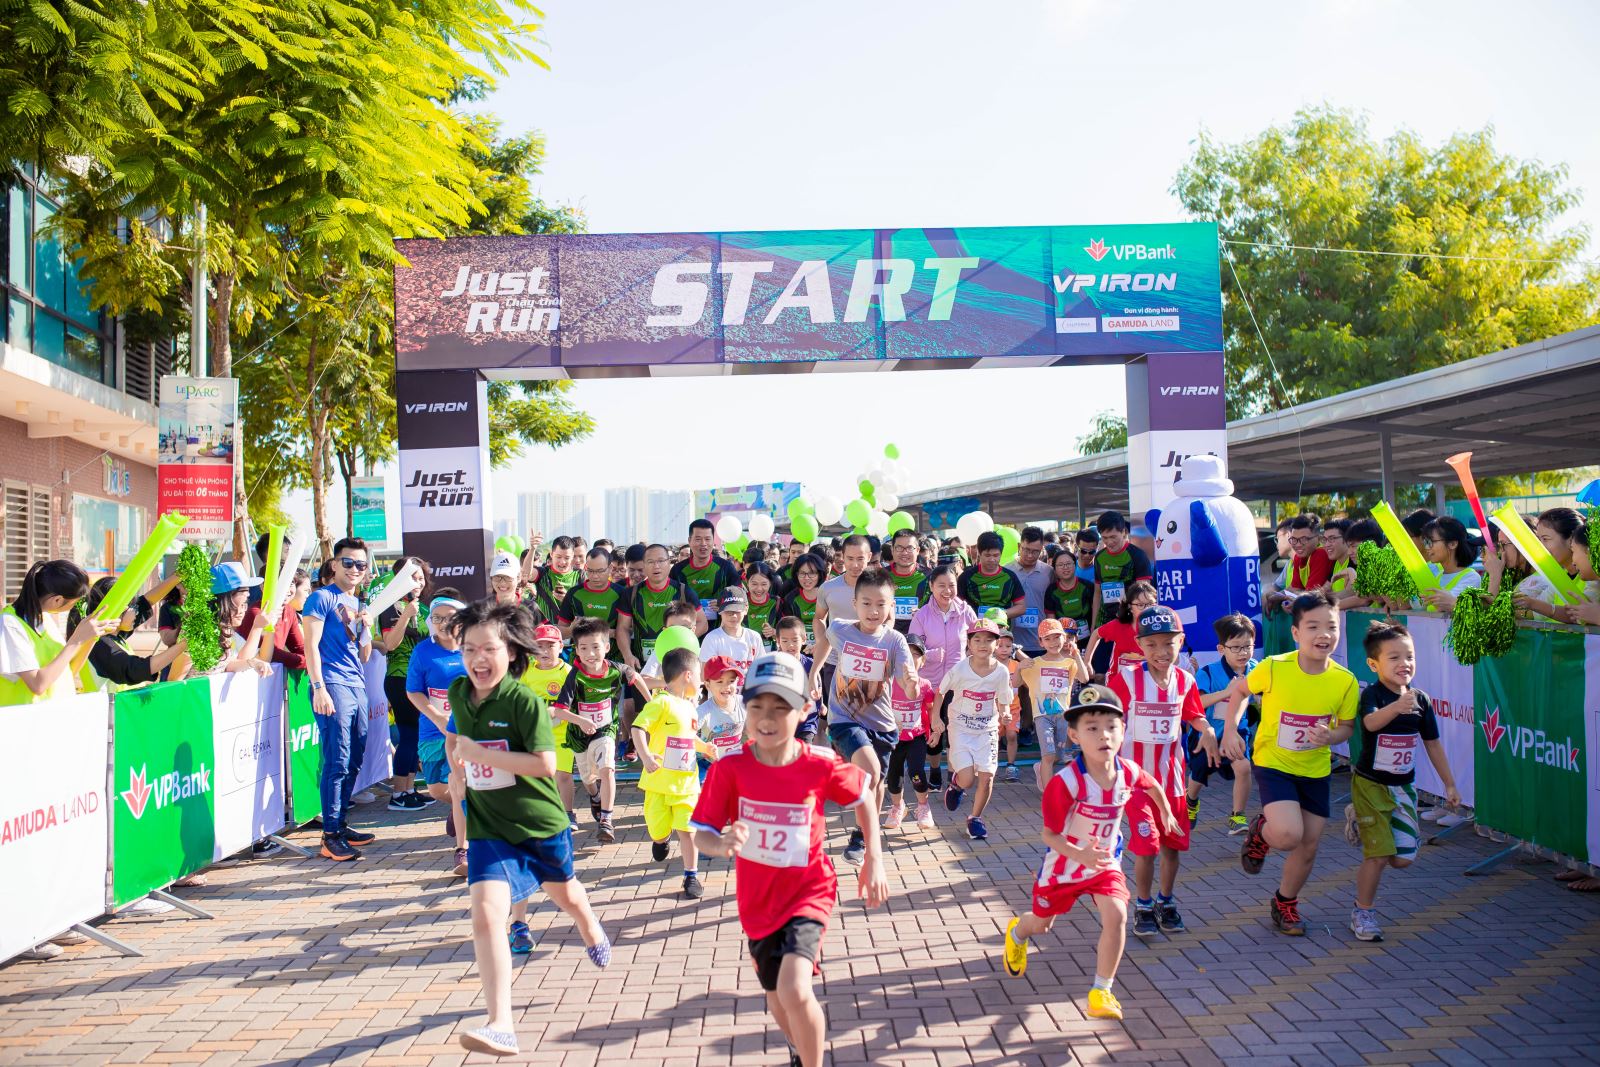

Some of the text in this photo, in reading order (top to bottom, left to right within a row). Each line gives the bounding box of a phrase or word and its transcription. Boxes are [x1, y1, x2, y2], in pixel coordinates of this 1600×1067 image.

[1112, 244, 1177, 260] VPBank
[441, 266, 551, 298] Just
[1053, 273, 1177, 293] VP IRON
[646, 257, 980, 326] START
[465, 301, 561, 333] Run
[1108, 319, 1174, 328] GAMUDA LAND
[1160, 385, 1220, 396] VP IRON
[405, 401, 468, 414] VP IRON
[405, 470, 467, 487] Just
[196, 487, 208, 497] 06
[419, 490, 474, 508] Run
[205, 527, 226, 535] LAND
[435, 565, 475, 577] IRON
[896, 606, 912, 615] 135
[1020, 616, 1035, 625] 149
[1141, 614, 1172, 626] GUCCI
[852, 659, 872, 673] 25
[1049, 677, 1063, 689] 45
[975, 703, 983, 712] 9
[1430, 698, 1453, 719] MUDA
[591, 713, 604, 723] 15
[901, 713, 915, 723] 11
[1150, 719, 1170, 734] 13
[291, 723, 312, 752] VP
[1506, 724, 1580, 773] VPBank
[681, 751, 689, 764] 4
[1392, 750, 1412, 766] 26
[470, 760, 494, 779] 38
[154, 762, 211, 810] VPBank
[0, 791, 99, 846] AMUDA LAND
[1088, 823, 1114, 838] 10
[757, 828, 788, 852] 12
